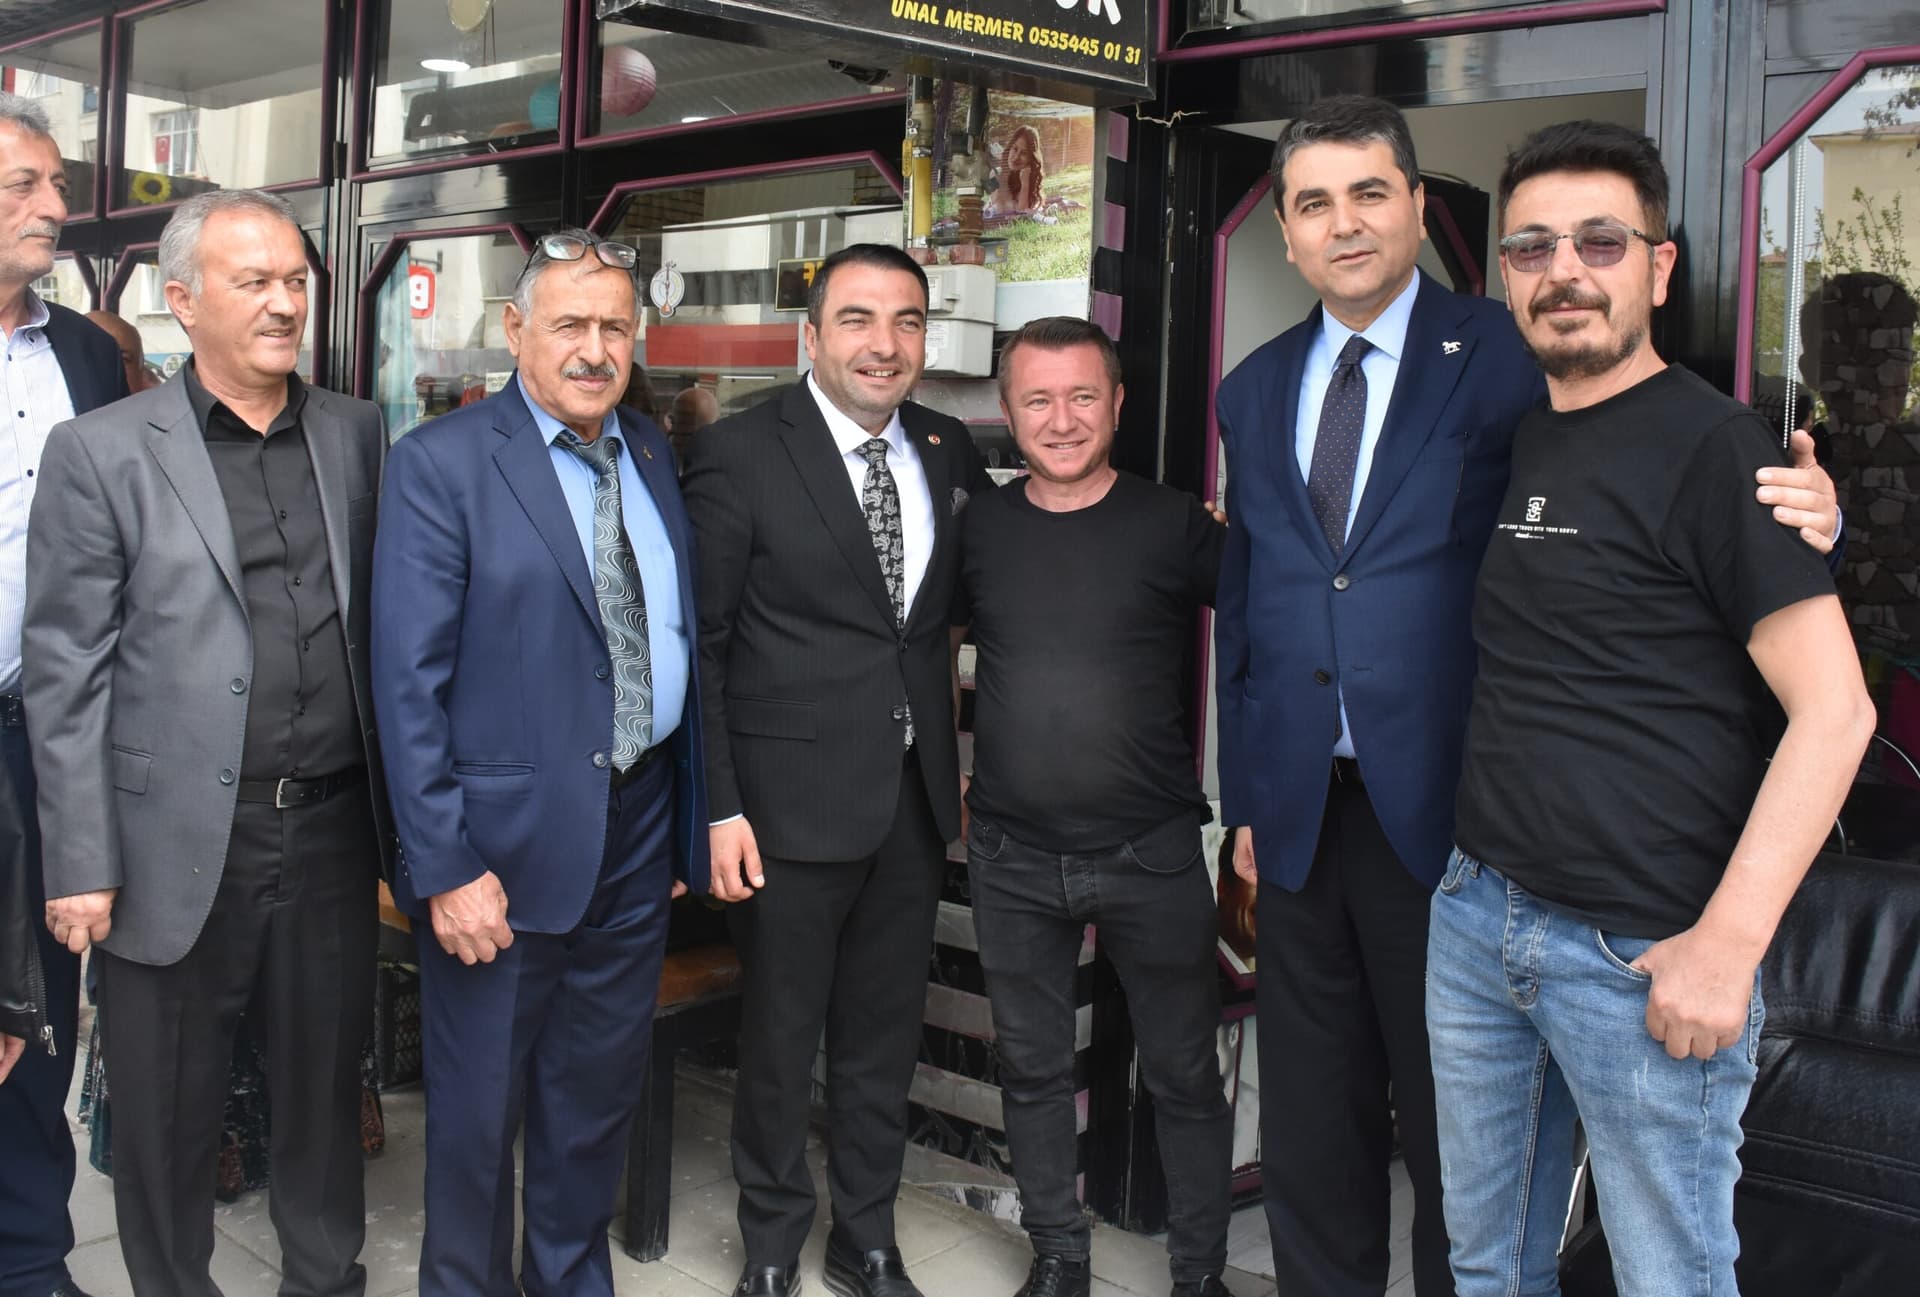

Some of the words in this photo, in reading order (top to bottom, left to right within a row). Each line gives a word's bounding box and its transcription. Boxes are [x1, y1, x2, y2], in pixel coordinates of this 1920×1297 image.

[944, 9, 1024, 43] MERMER
[1028, 26, 1100, 57] 0535445
[1104, 42, 1122, 61] 01
[1124, 46, 1142, 65] 31
